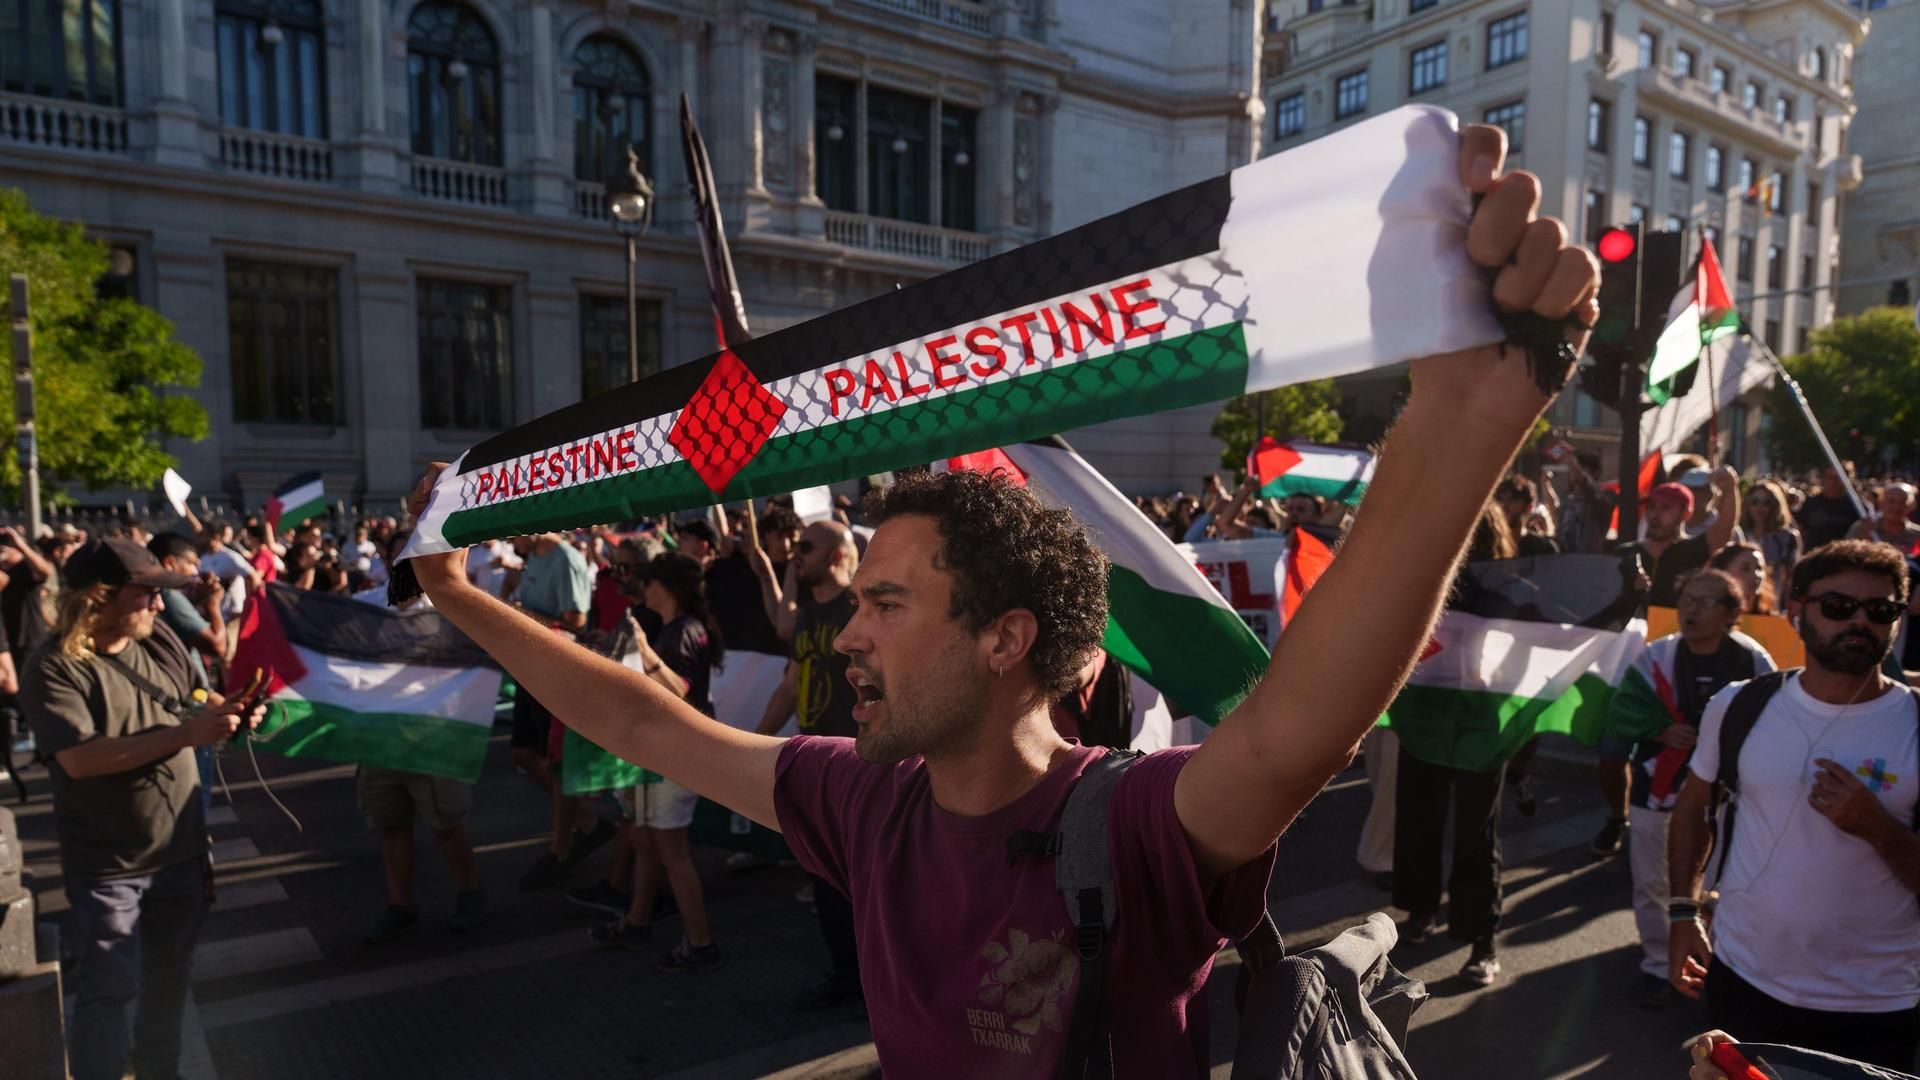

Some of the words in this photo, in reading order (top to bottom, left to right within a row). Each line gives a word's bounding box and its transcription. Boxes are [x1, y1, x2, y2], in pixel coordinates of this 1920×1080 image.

[824, 278, 1166, 417] PALESTINE
[475, 430, 636, 504] PALESTINE
[967, 1008, 1005, 1030] BERRI
[970, 1027, 1032, 1054] TXARRAK
